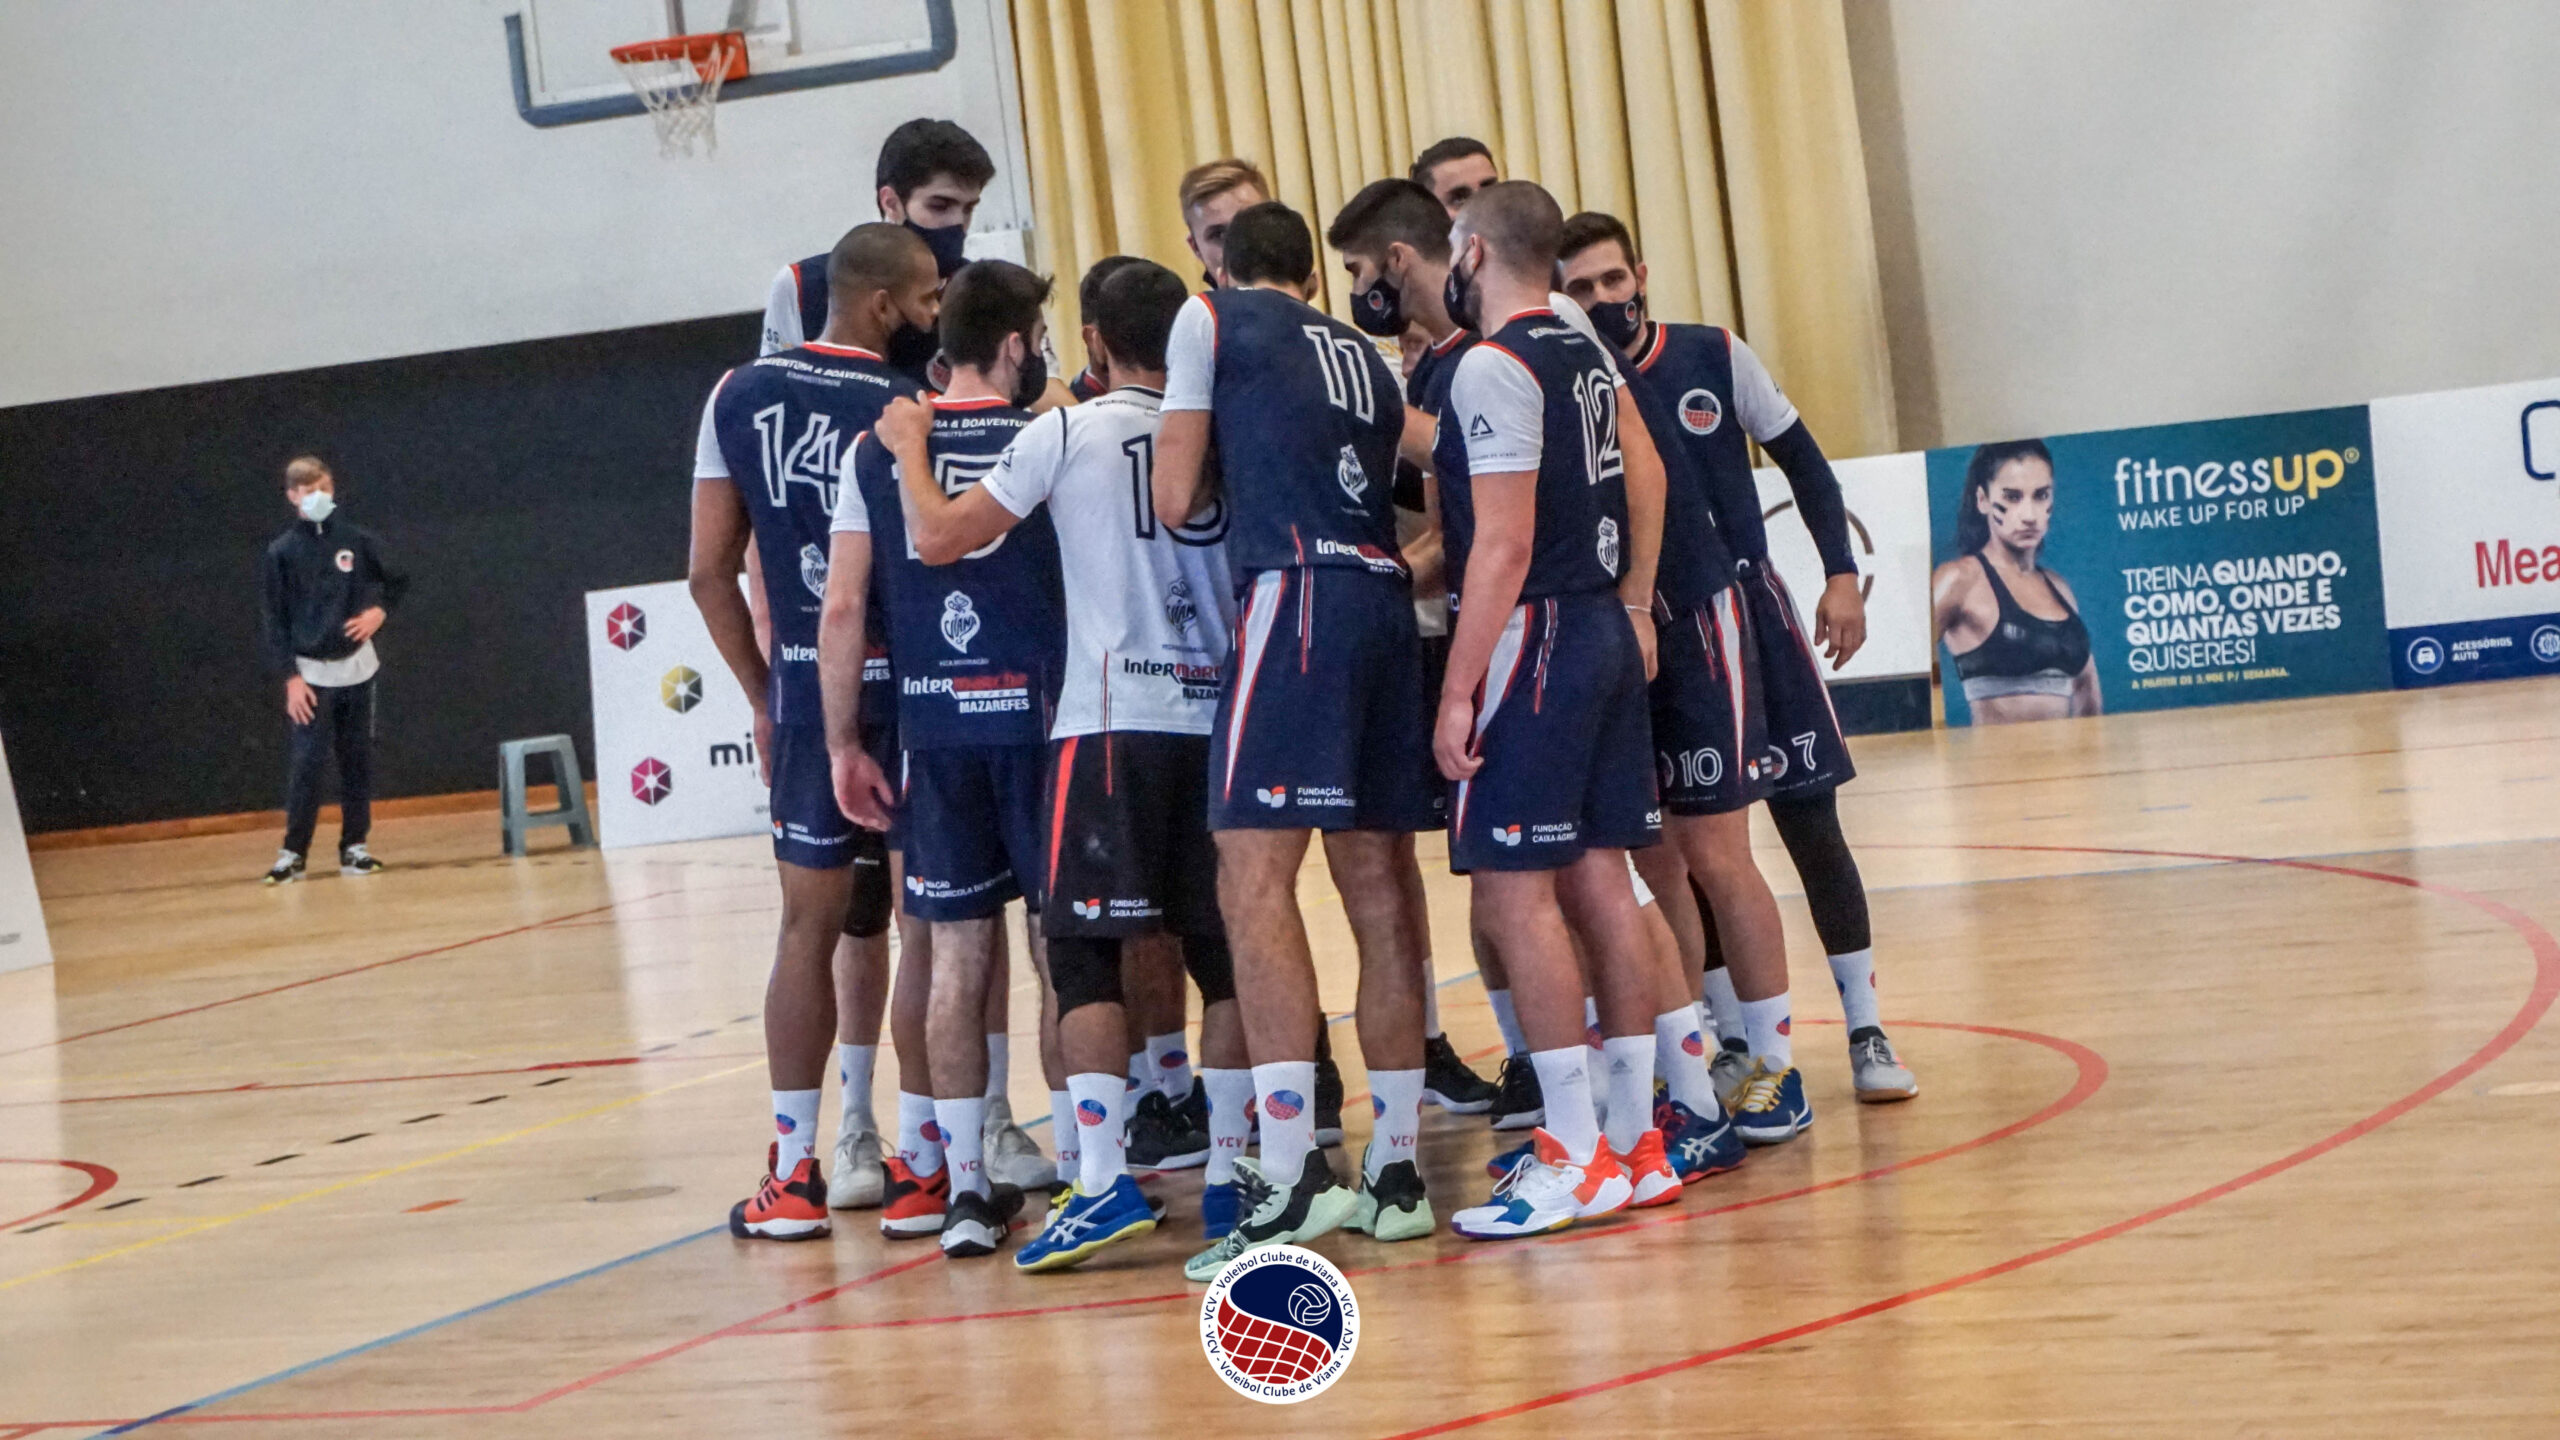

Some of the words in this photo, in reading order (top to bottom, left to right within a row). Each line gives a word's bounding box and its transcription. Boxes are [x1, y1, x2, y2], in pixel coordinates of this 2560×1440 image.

[823, 368, 890, 388] BOAVENTURA
[1302, 324, 1375, 425] 11
[1572, 368, 1624, 486] 12
[753, 402, 841, 517] 14
[2115, 449, 2345, 506] fitnessup
[2118, 506, 2182, 531] WAKE
[2188, 502, 2219, 525] UP
[2224, 498, 2268, 521] FOR
[2274, 494, 2305, 516] UP
[2122, 562, 2213, 593] TREINA
[2212, 550, 2347, 585] QUANDO,
[2124, 587, 2225, 620] COMO,
[2229, 580, 2310, 611] ONDE
[2317, 578, 2332, 603] E
[2126, 611, 2259, 647] QUANTAS
[2261, 604, 2342, 634] VEZES
[2128, 638, 2256, 673] QUISERES!
[2452, 650, 2479, 661] AUTO
[959, 698, 1030, 714] MAZAREFES
[1679, 747, 1723, 788] 10
[1791, 730, 1817, 771] 7
[1297, 785, 1344, 797] FUNDAÇÃO
[1297, 797, 1322, 806] CAIXA
[1532, 834, 1556, 843] CAIXA
[1217, 1136, 1245, 1148] VCV
[1390, 1135, 1415, 1148] VCV
